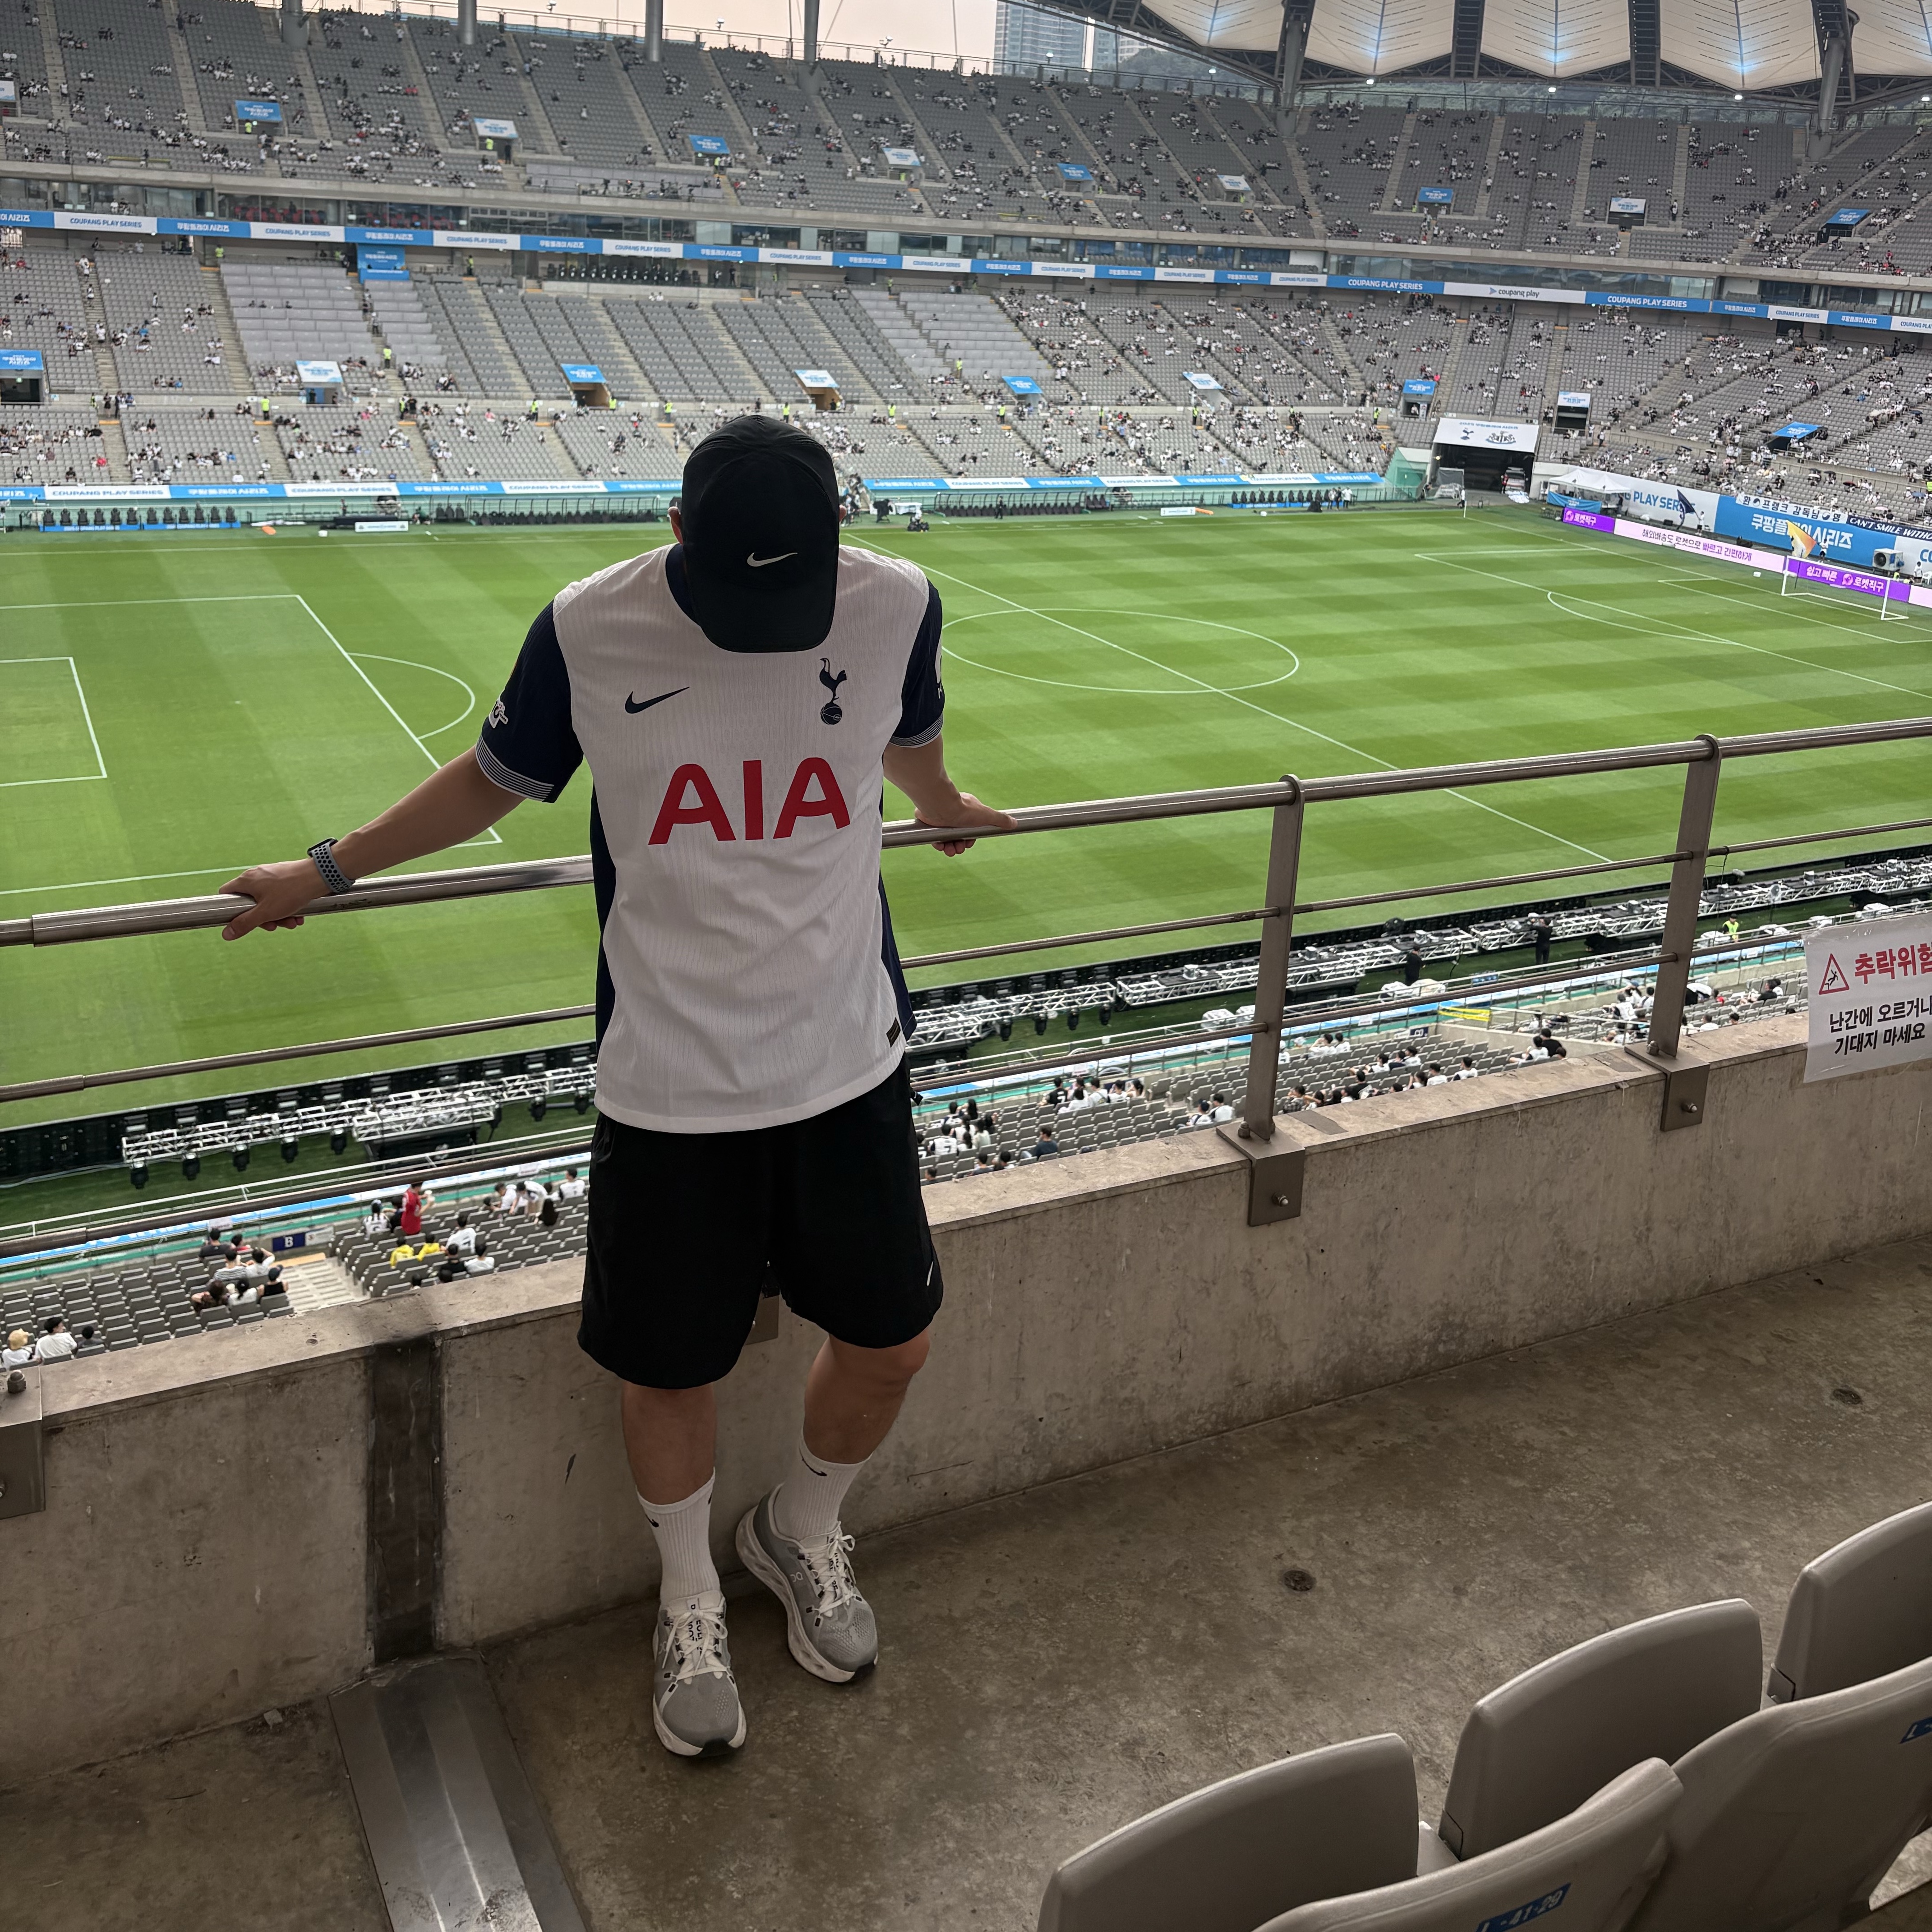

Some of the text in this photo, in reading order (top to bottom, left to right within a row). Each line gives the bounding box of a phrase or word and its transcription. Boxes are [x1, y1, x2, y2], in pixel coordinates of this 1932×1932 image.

[70, 218, 101, 226] COUPANG
[1348, 279, 1380, 287] COUPANG
[1399, 282, 1423, 290] SERIES
[1526, 289, 1540, 299] play
[1607, 296, 1641, 305] COUPANG
[1662, 299, 1687, 308] SERIES
[1633, 491, 1659, 506] PLAY
[1574, 513, 1596, 526] 로켓직구
[1761, 501, 1788, 513] 프랭크
[1793, 506, 1820, 520] 감독님
[1832, 513, 1841, 522] 영
[1752, 514, 1853, 549] 쿠팡플이 시리즈
[1849, 517, 1874, 529] CAN'T
[1874, 523, 1902, 534] SMILE
[1642, 529, 1752, 561] 해외배송도 로켓으로 빠르고 간편하게
[1854, 576, 1884, 593] 로켓직구
[648, 757, 850, 846] AIA
[1855, 943, 1932, 984] 추락위험
[1830, 1006, 1873, 1033] 난간에
[1835, 1022, 1925, 1055] 기대지 마세요
[285, 1236, 293, 1247] B
